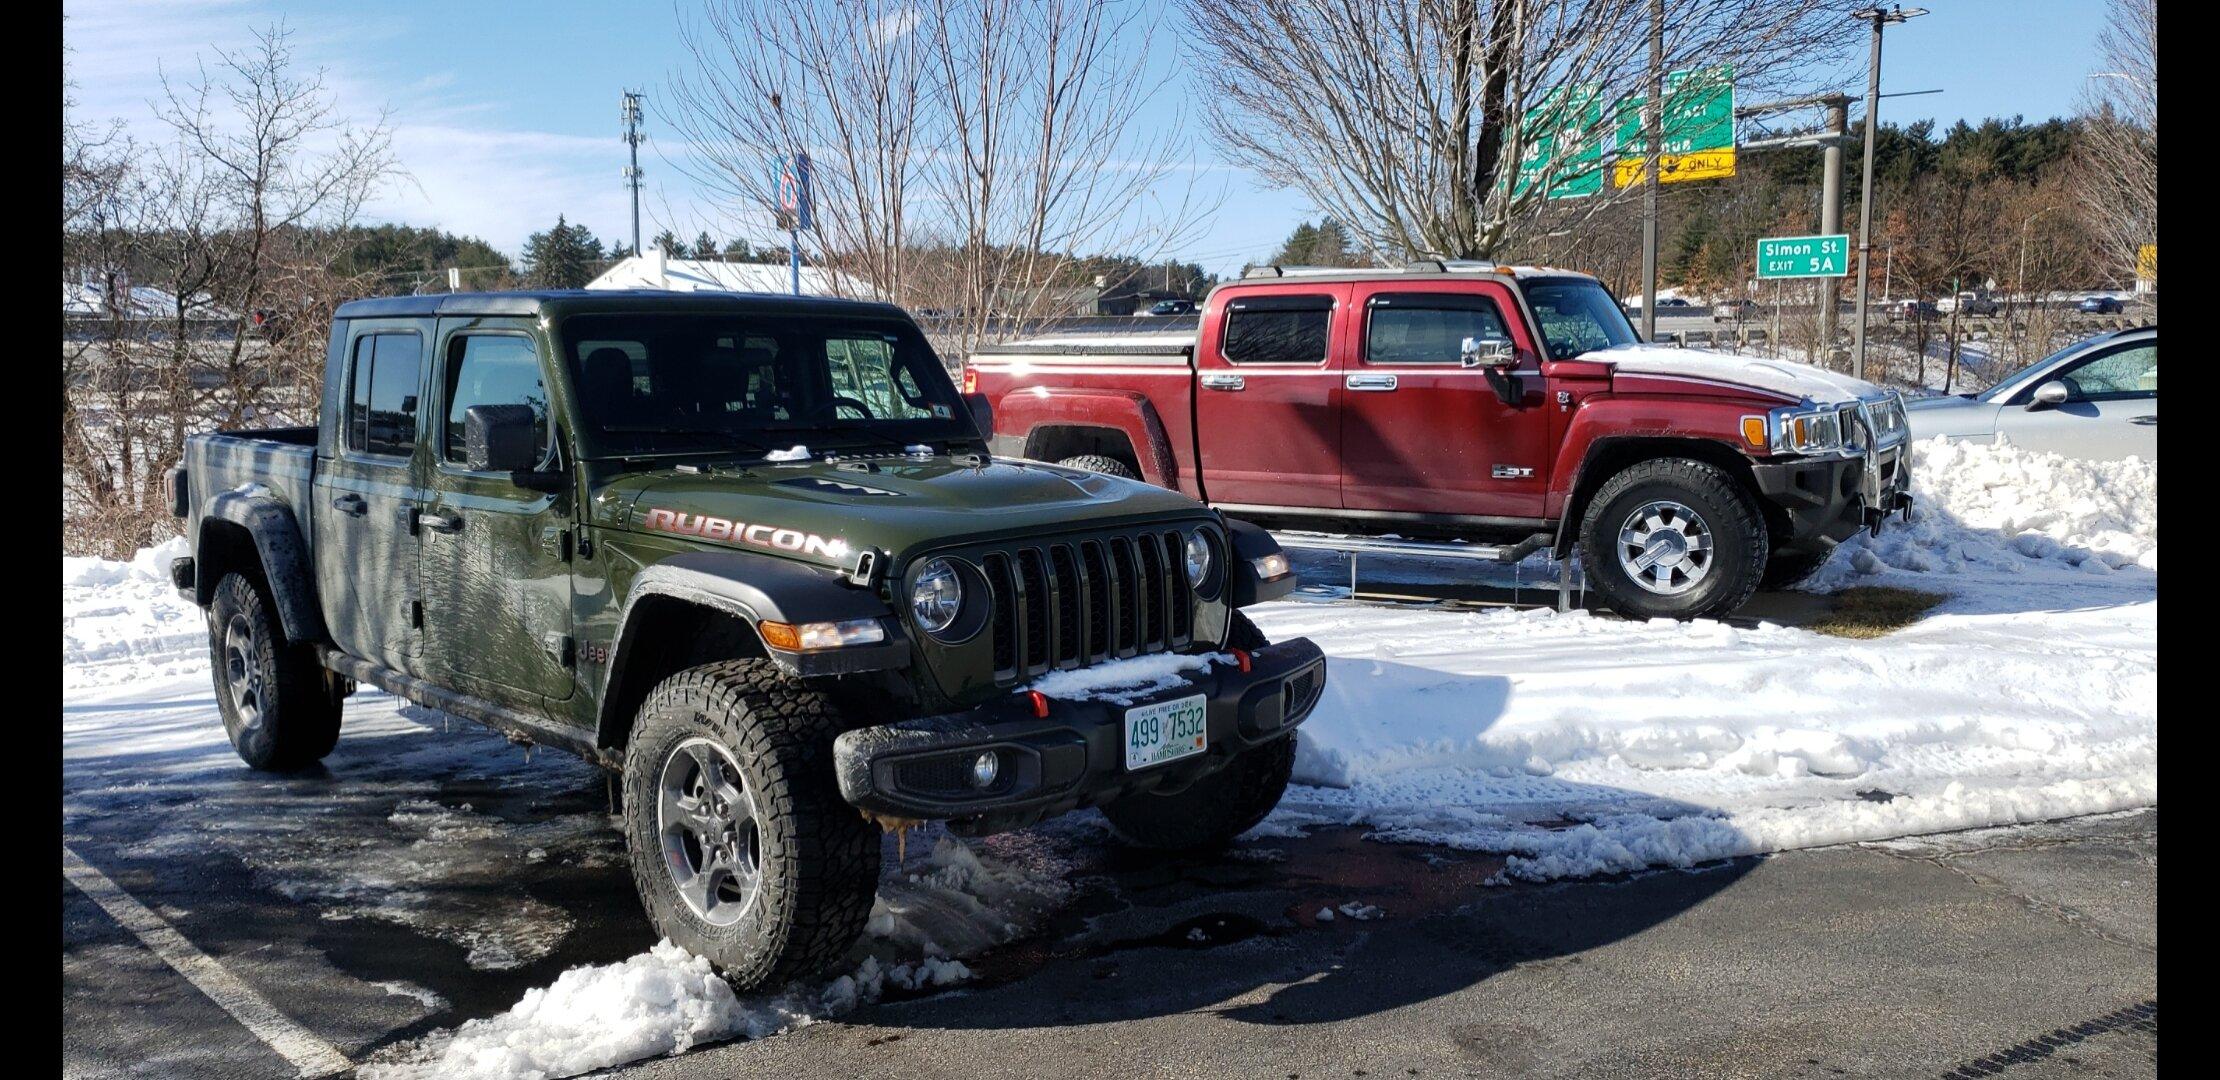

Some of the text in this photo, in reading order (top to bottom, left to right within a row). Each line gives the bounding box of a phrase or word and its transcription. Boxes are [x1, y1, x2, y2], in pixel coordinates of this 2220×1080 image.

[1689, 157, 1722, 171] ONLY
[1765, 241, 1840, 257] Simon St.
[1769, 256, 1834, 272] EXIT 5A
[646, 508, 848, 559] RUBICON
[1131, 706, 1204, 749] 499 7532
